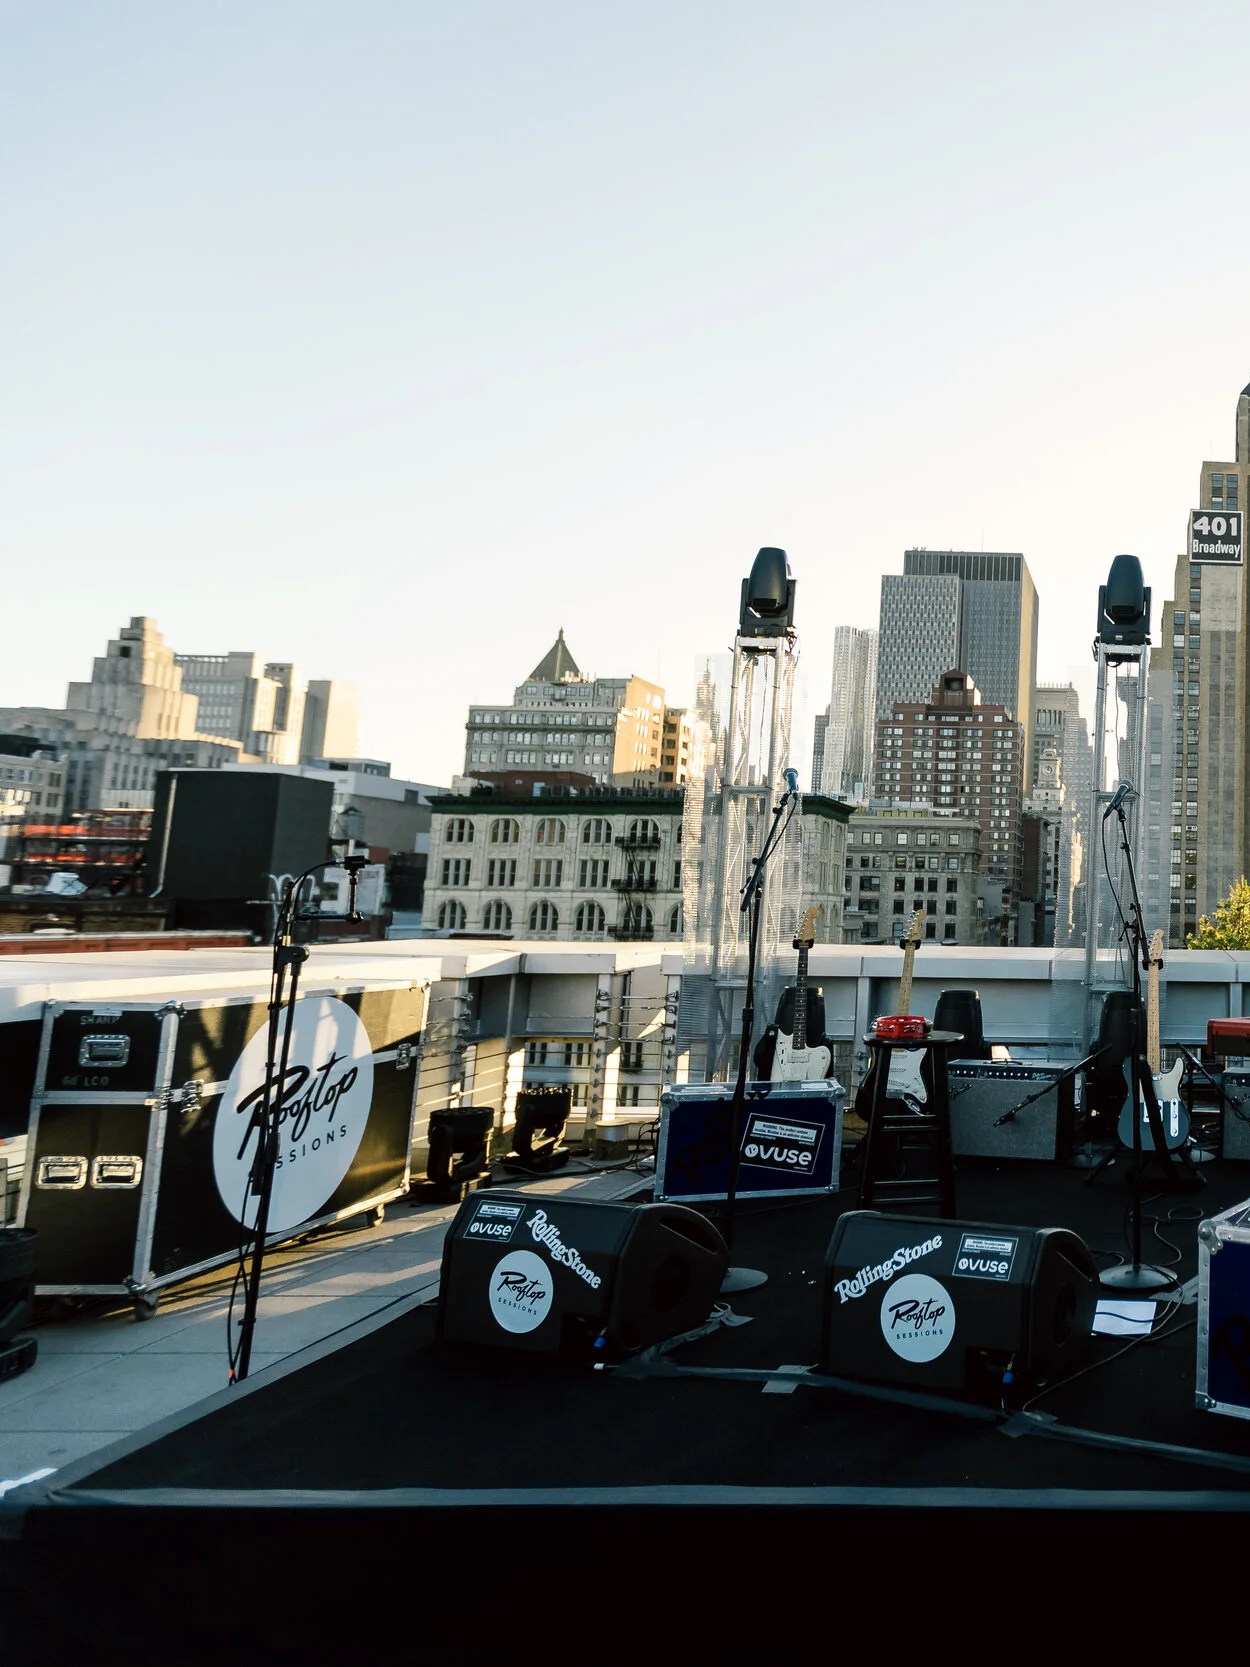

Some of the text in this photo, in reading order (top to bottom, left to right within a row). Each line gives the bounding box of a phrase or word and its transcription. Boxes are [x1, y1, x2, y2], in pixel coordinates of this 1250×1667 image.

[1193, 516, 1238, 536] 401
[1193, 539, 1240, 558] Broadway
[497, 1271, 546, 1305] Rooftop
[498, 1297, 537, 1316] SESSIONS
[889, 1297, 946, 1330] Rooftop
[896, 1329, 944, 1340] SESSIONS
